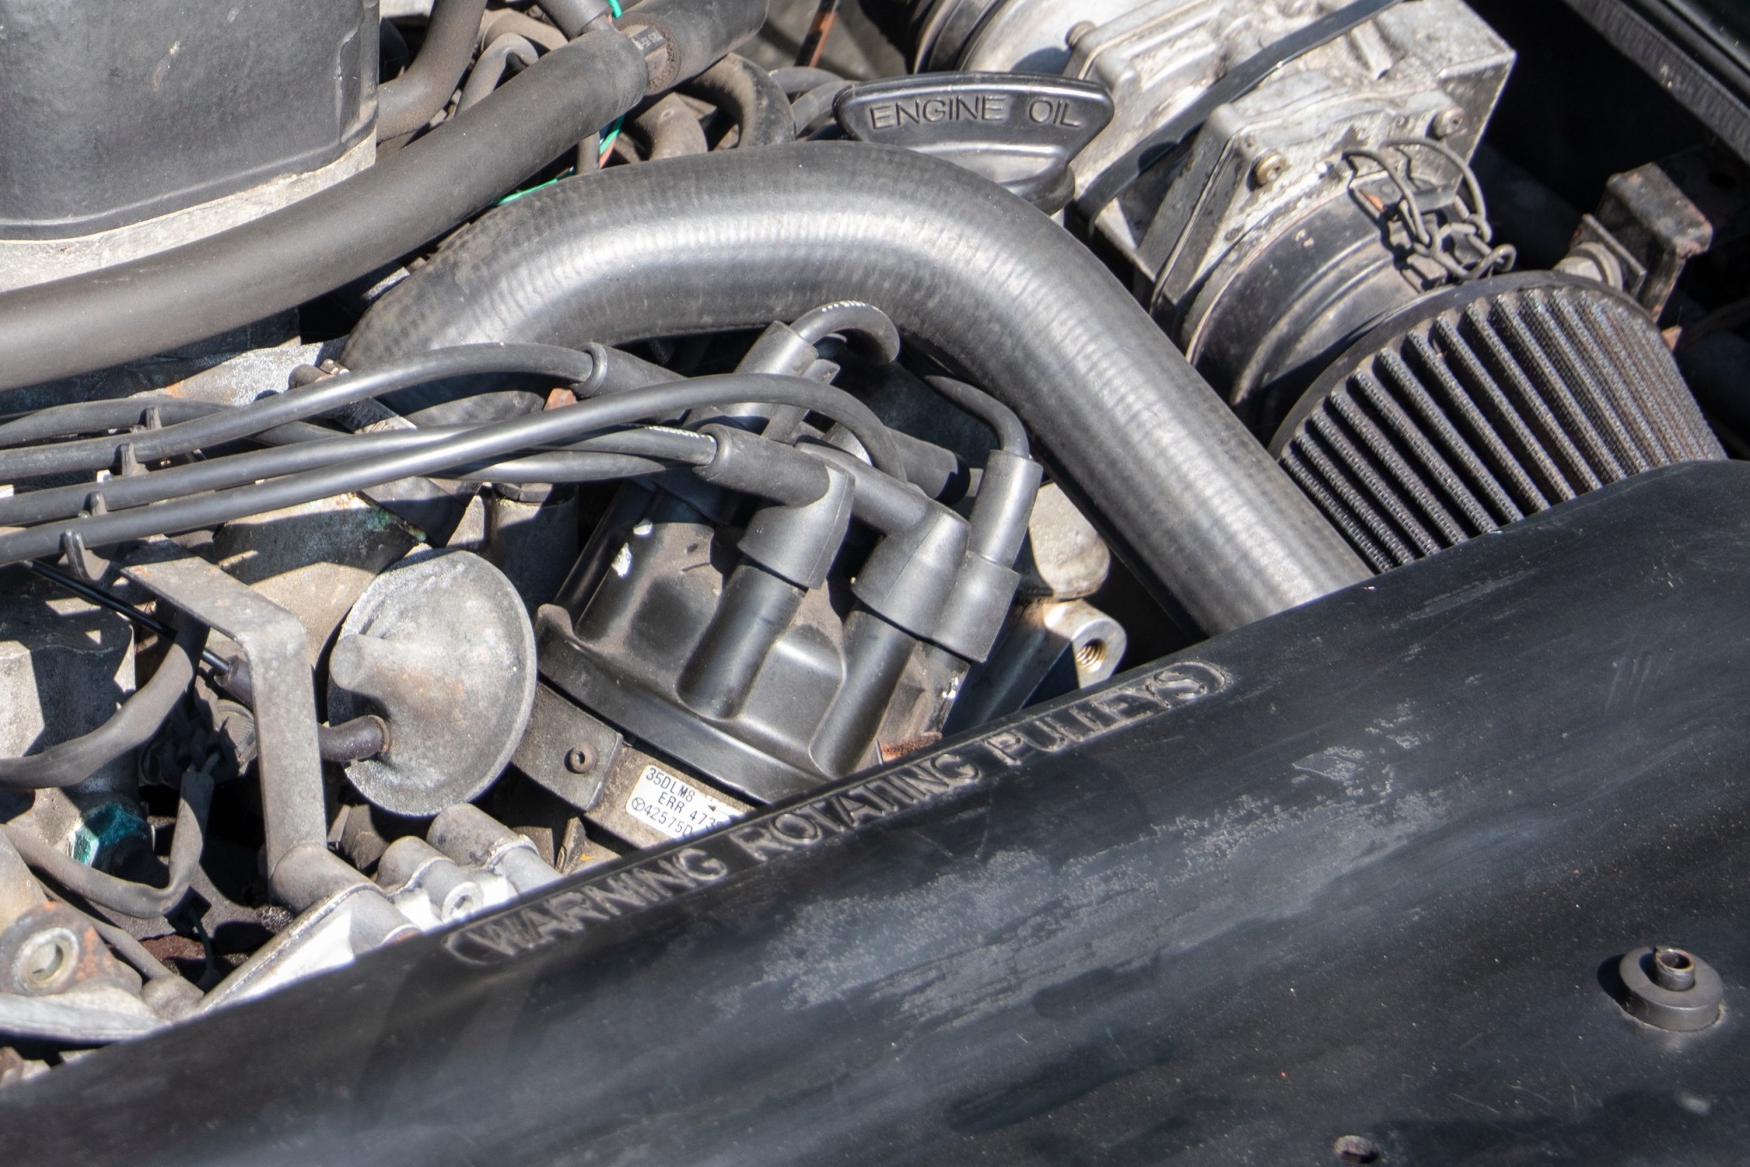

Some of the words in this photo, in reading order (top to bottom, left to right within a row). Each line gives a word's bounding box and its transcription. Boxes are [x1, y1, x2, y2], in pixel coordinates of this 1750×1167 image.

[870, 95, 1007, 130] ENGINE
[1029, 98, 1082, 128] OIL
[646, 767, 696, 803] 35DLM8
[465, 848, 729, 957] WARNING
[728, 753, 982, 861] ROTATING
[982, 671, 1208, 766] PULLEYS
[658, 793, 685, 814] ERR
